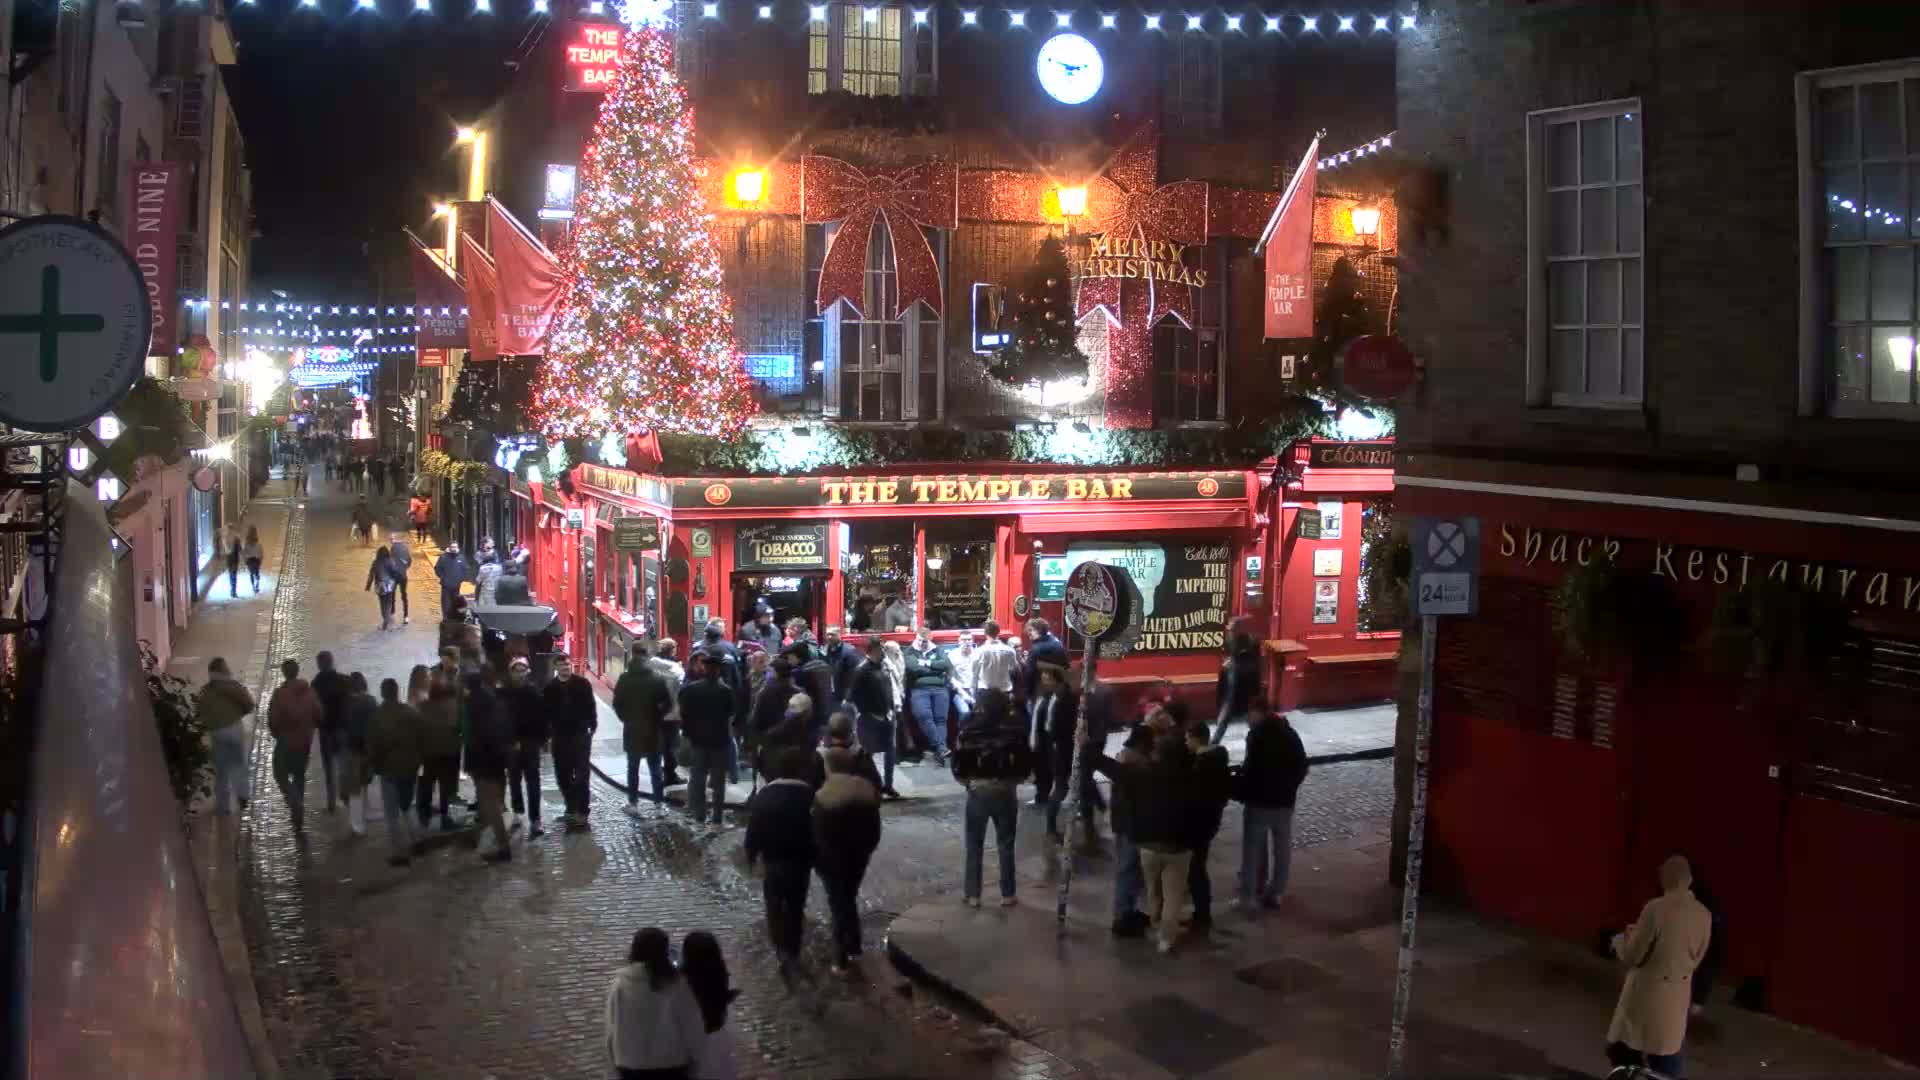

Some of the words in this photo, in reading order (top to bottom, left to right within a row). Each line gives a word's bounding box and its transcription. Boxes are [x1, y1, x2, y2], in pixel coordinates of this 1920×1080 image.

[583, 28, 618, 46] THE
[567, 47, 623, 64] TEMPL
[137, 171, 169, 232] NINE
[1088, 237, 1186, 261] MERRY
[1070, 258, 1207, 288] HRISTMAS
[1275, 274, 1290, 286] THE
[1268, 285, 1306, 300] TEMPLE
[424, 318, 466, 328] TEMPLE
[501, 314, 552, 326] TEMP
[433, 328, 457, 337] BAR
[822, 481, 899, 504] THE
[911, 479, 1051, 503] TEMPLE
[1065, 478, 1133, 500] BAR
[787, 533, 816, 541] SMOKING
[751, 538, 817, 561] TOBACCO
[1121, 546, 1146, 557] THE
[1111, 557, 1157, 568] TEMPLE
[1203, 563, 1227, 578] THE
[1175, 577, 1227, 594] EMPEROR
[1423, 584, 1443, 602] 24
[1211, 593, 1226, 608] OF
[1134, 631, 1225, 651] GUINNESS
